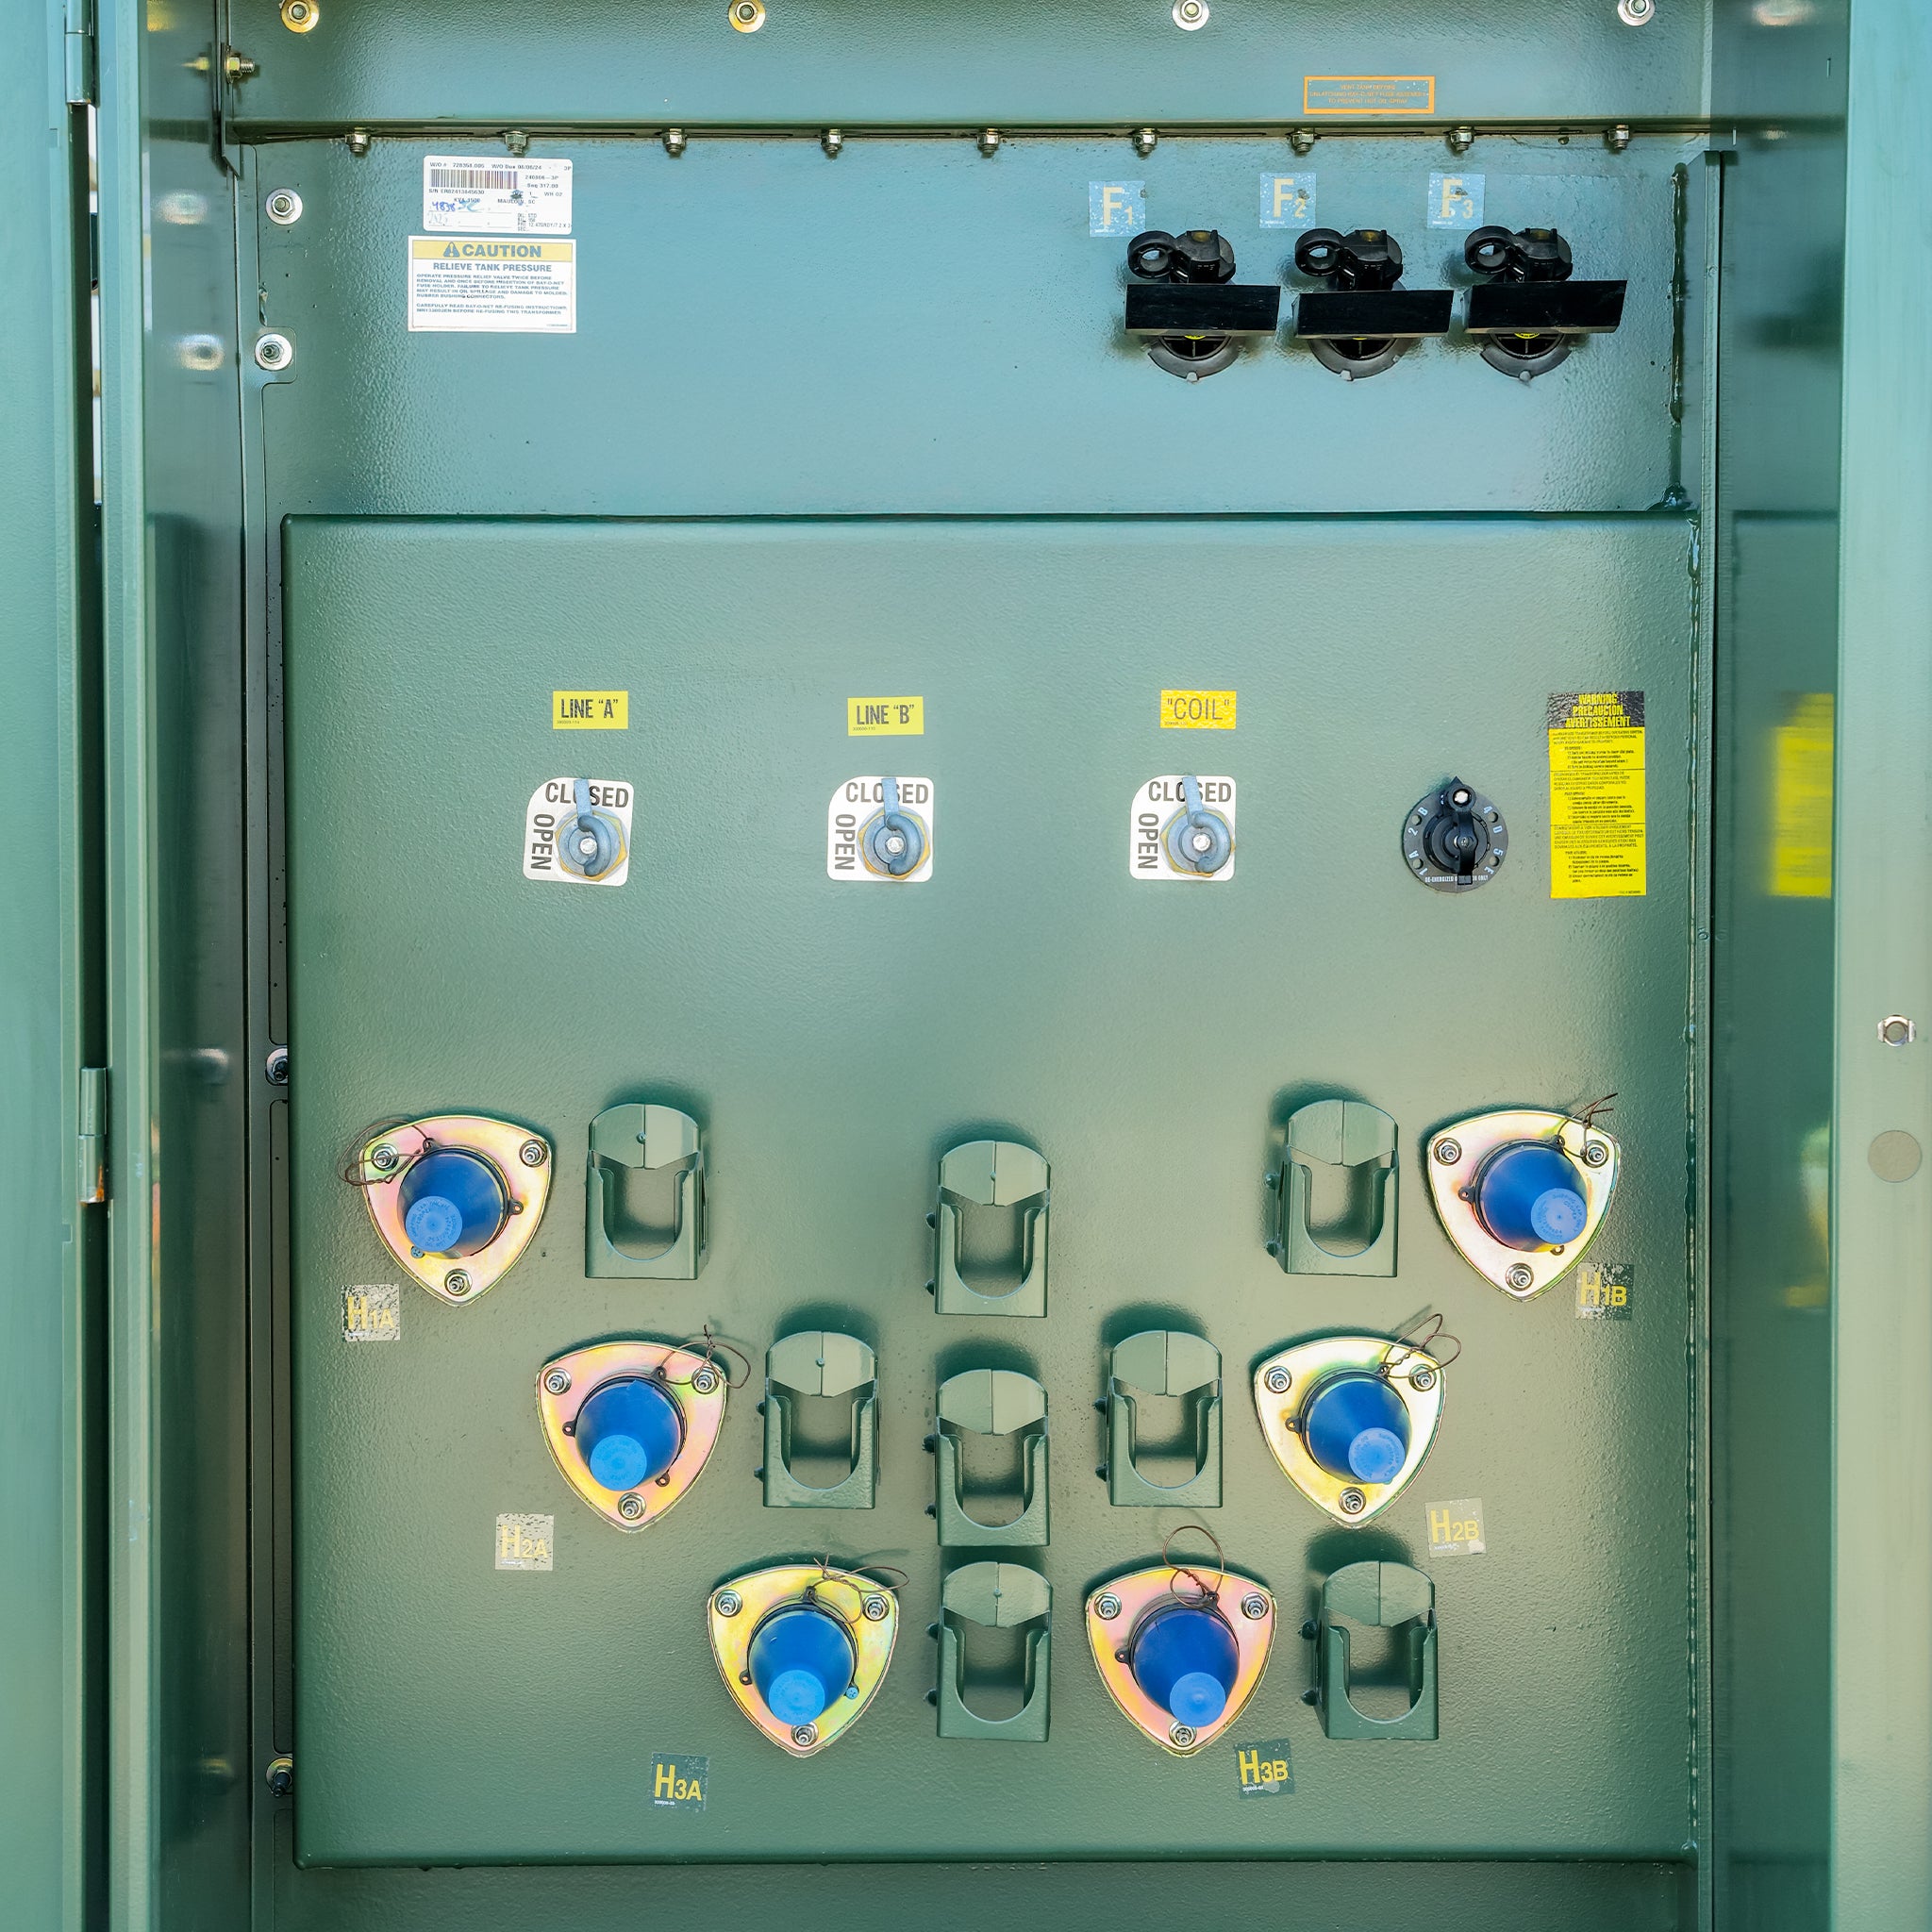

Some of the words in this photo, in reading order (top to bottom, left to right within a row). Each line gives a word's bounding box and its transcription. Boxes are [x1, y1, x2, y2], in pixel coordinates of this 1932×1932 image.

[433, 262, 473, 271] RELIEVE
[503, 264, 553, 273] PRESSURE
[462, 244, 541, 258] CAUTION
[560, 698, 593, 719] LINE
[857, 705, 890, 725] LINE
[1578, 693, 1618, 705] WARNING
[1565, 716, 1631, 727] AVERTISSEMENT
[545, 782, 629, 808] CLSED
[531, 813, 556, 870] OPEN
[835, 814, 857, 870] OPEN
[1138, 813, 1159, 869] OPEN
[1580, 1272, 1627, 1307] H1B
[347, 1296, 394, 1329] H1A
[501, 1524, 548, 1558] H2A
[1430, 1508, 1480, 1543] H2B
[654, 1763, 703, 1801] H3A
[1238, 1749, 1289, 1785] H3B
